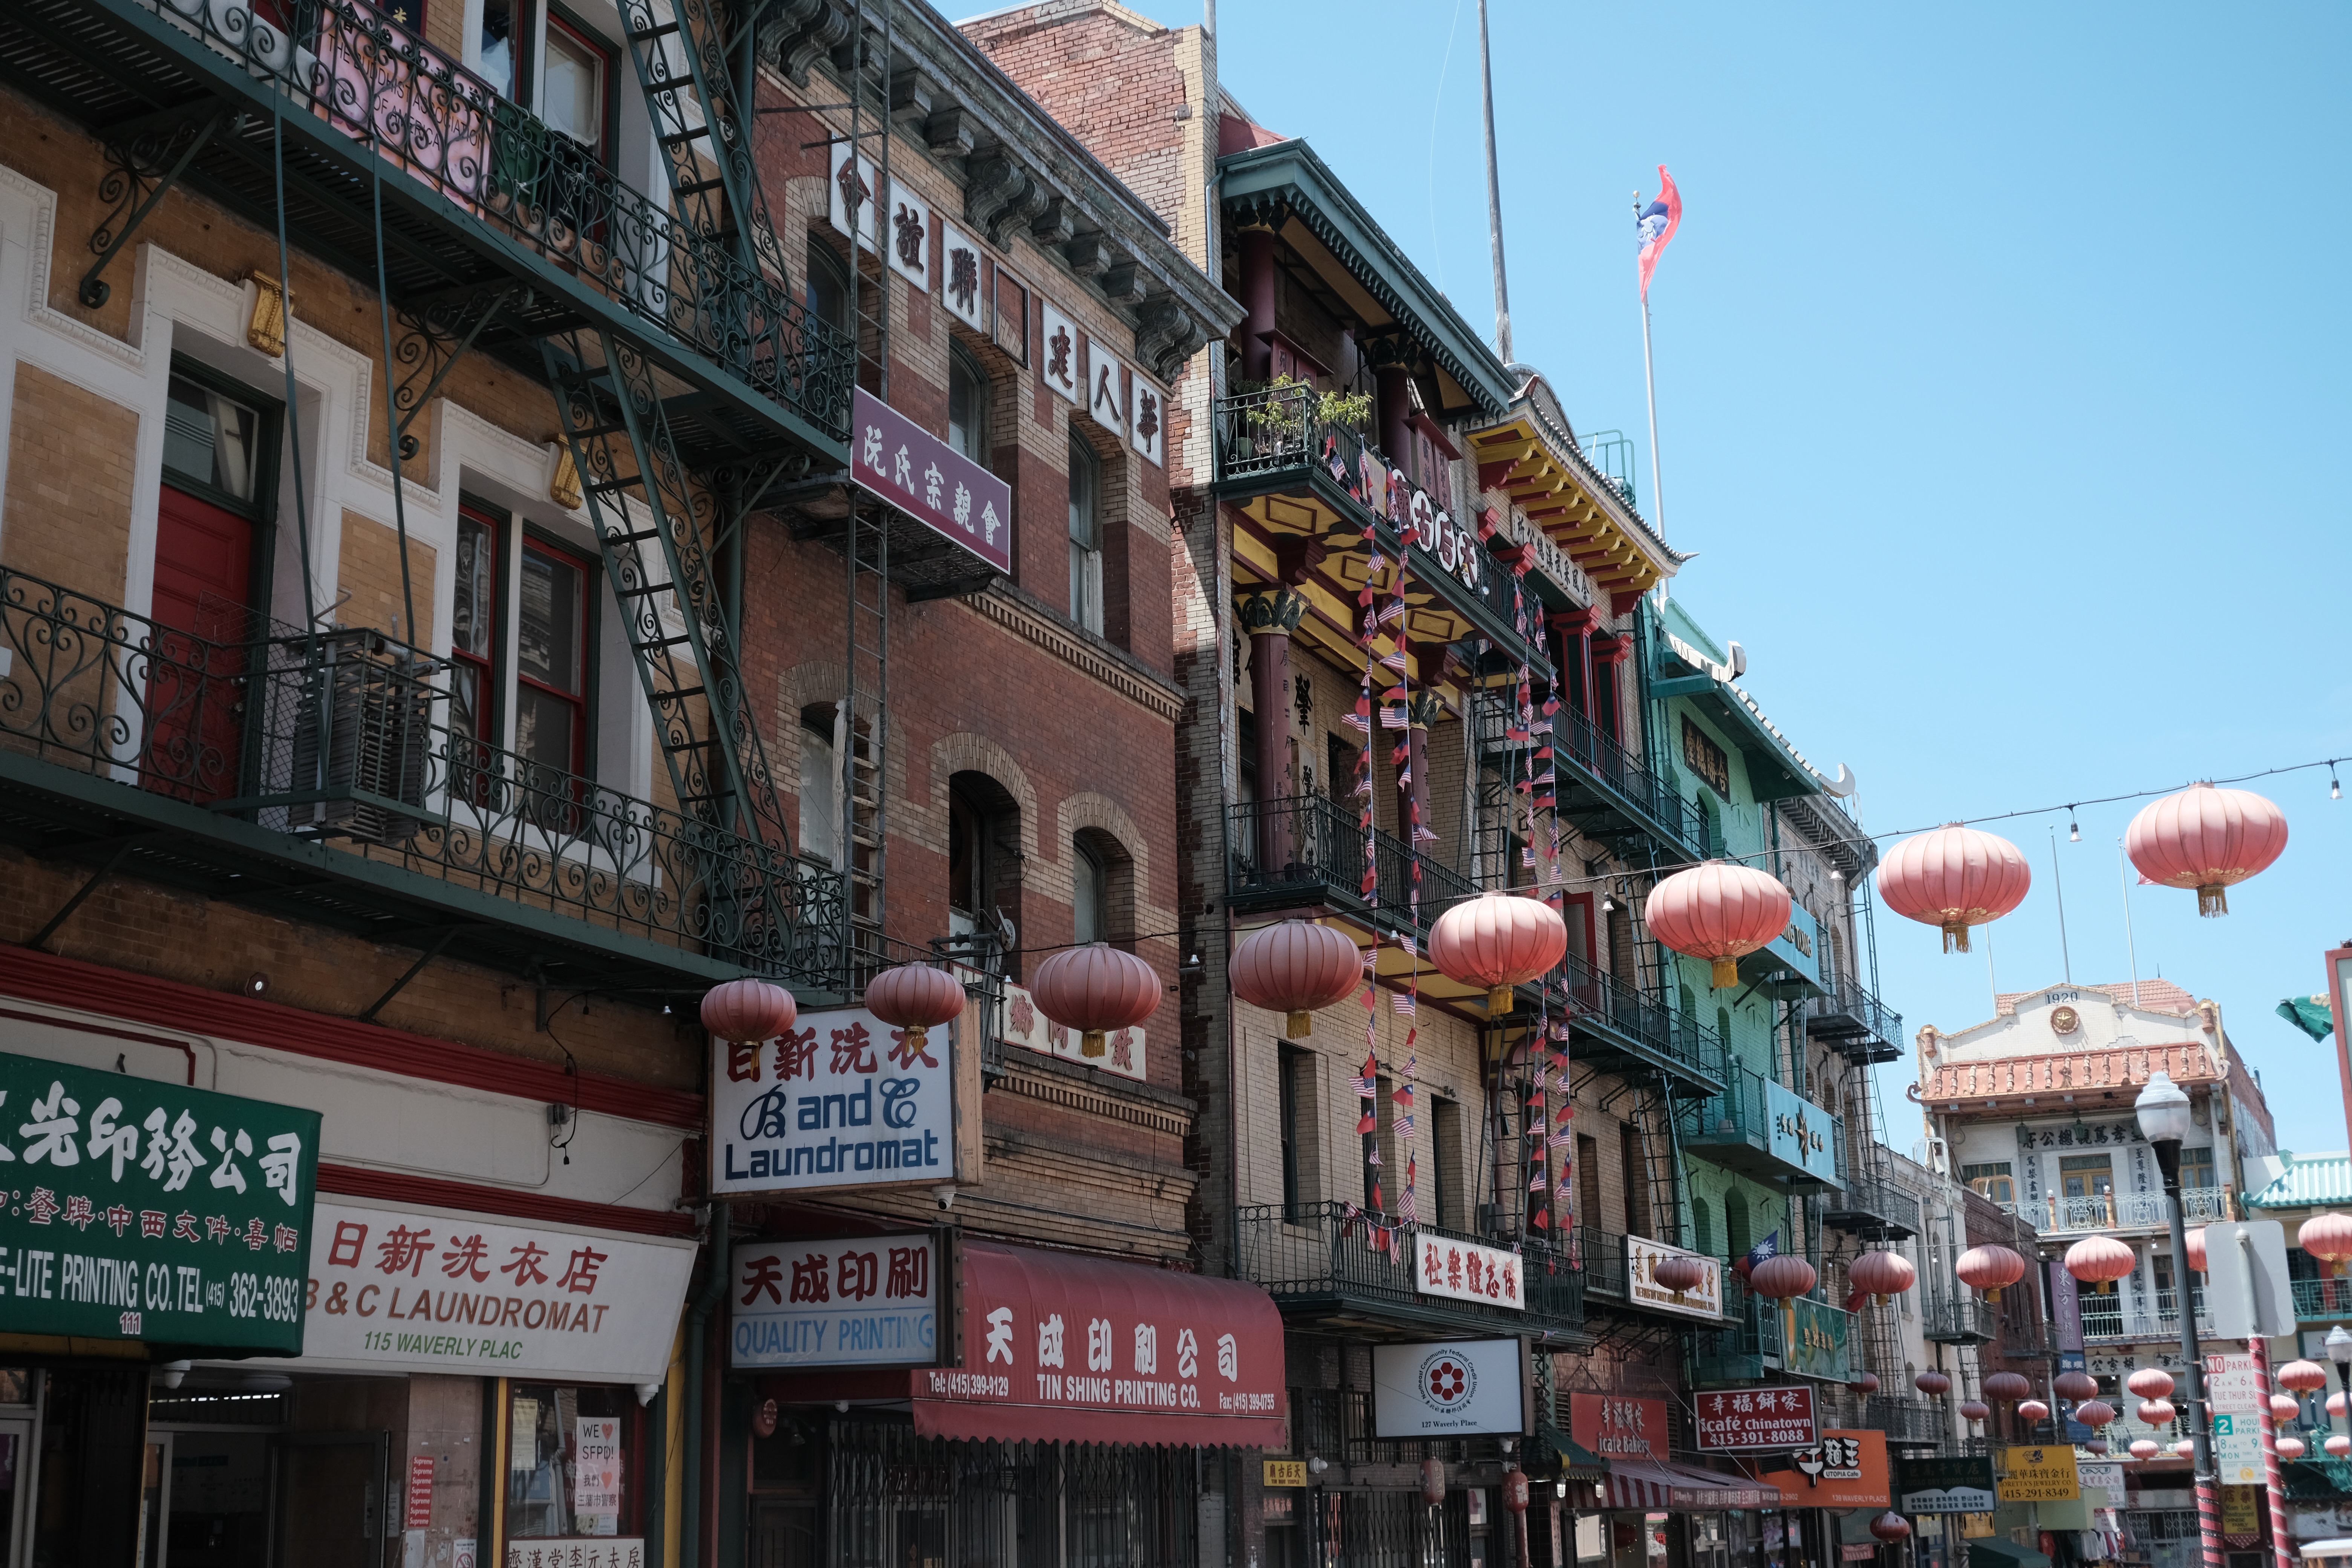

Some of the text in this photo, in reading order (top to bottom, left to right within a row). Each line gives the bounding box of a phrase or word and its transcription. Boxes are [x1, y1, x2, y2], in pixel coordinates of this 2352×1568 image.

[2047, 992, 2078, 1004] 1920
[740, 1078, 920, 1141] B and C
[725, 1129, 939, 1180] Laundromat
[328, 1220, 608, 1295] 日新洗衣店
[741, 1246, 928, 1306] 天成印刷
[61, 1254, 138, 1308] PRINTING
[145, 1263, 172, 1311] CO.
[177, 1266, 204, 1313] TEL
[206, 1280, 225, 1309] (415)
[230, 1272, 299, 1323] 362-3893
[325, 1282, 348, 1315] &
[356, 1284, 380, 1318] C
[387, 1286, 609, 1334] LAUNDROMAT
[119, 1311, 141, 1335] 111
[735, 1314, 933, 1357] QUALITY PRINTING
[364, 1331, 523, 1359] 115 WAVERLY PLAC
[986, 1306, 1237, 1383] 天成印刷公司
[2208, 1358, 2252, 1372] NO PARKI
[1418, 1349, 1477, 1400] Northeast Community Federal Credit Union
[2214, 1377, 2220, 1386] 2
[2240, 1376, 2246, 1386] 6
[929, 1372, 1009, 1400] Tel: (415) 399-9129
[1037, 1374, 1200, 1409] TIN SHING PRINTING CO.
[2214, 1392, 2226, 1400] TUE
[2228, 1391, 2246, 1400] THUR
[1219, 1392, 1274, 1415] Fax: (415) 399-0755
[1709, 1391, 1803, 1416] 幸福餅家
[583, 1424, 599, 1438] WE
[1701, 1416, 1811, 1432] icafé Chinatown
[2218, 1419, 2230, 1433] 2
[1710, 1429, 1805, 1445] 415-391-8088
[2220, 1439, 2226, 1449] 8
[2251, 1438, 2258, 1448] 9
[582, 1446, 614, 1459] SFPD!
[1623, 1435, 1650, 1458] Bakery
[413, 1456, 433, 1465] Supreme
[413, 1467, 432, 1476] Supreme
[412, 1477, 431, 1485] Supreme
[583, 1474, 599, 1487] 我們
[412, 1487, 430, 1495] Supreme
[2004, 1488, 2069, 1498] 415-291-8349
[411, 1497, 430, 1505] Supreme
[577, 1494, 617, 1507] 三藩市警察
[410, 1507, 429, 1516] Supreme
[409, 1517, 429, 1526] Supreme
